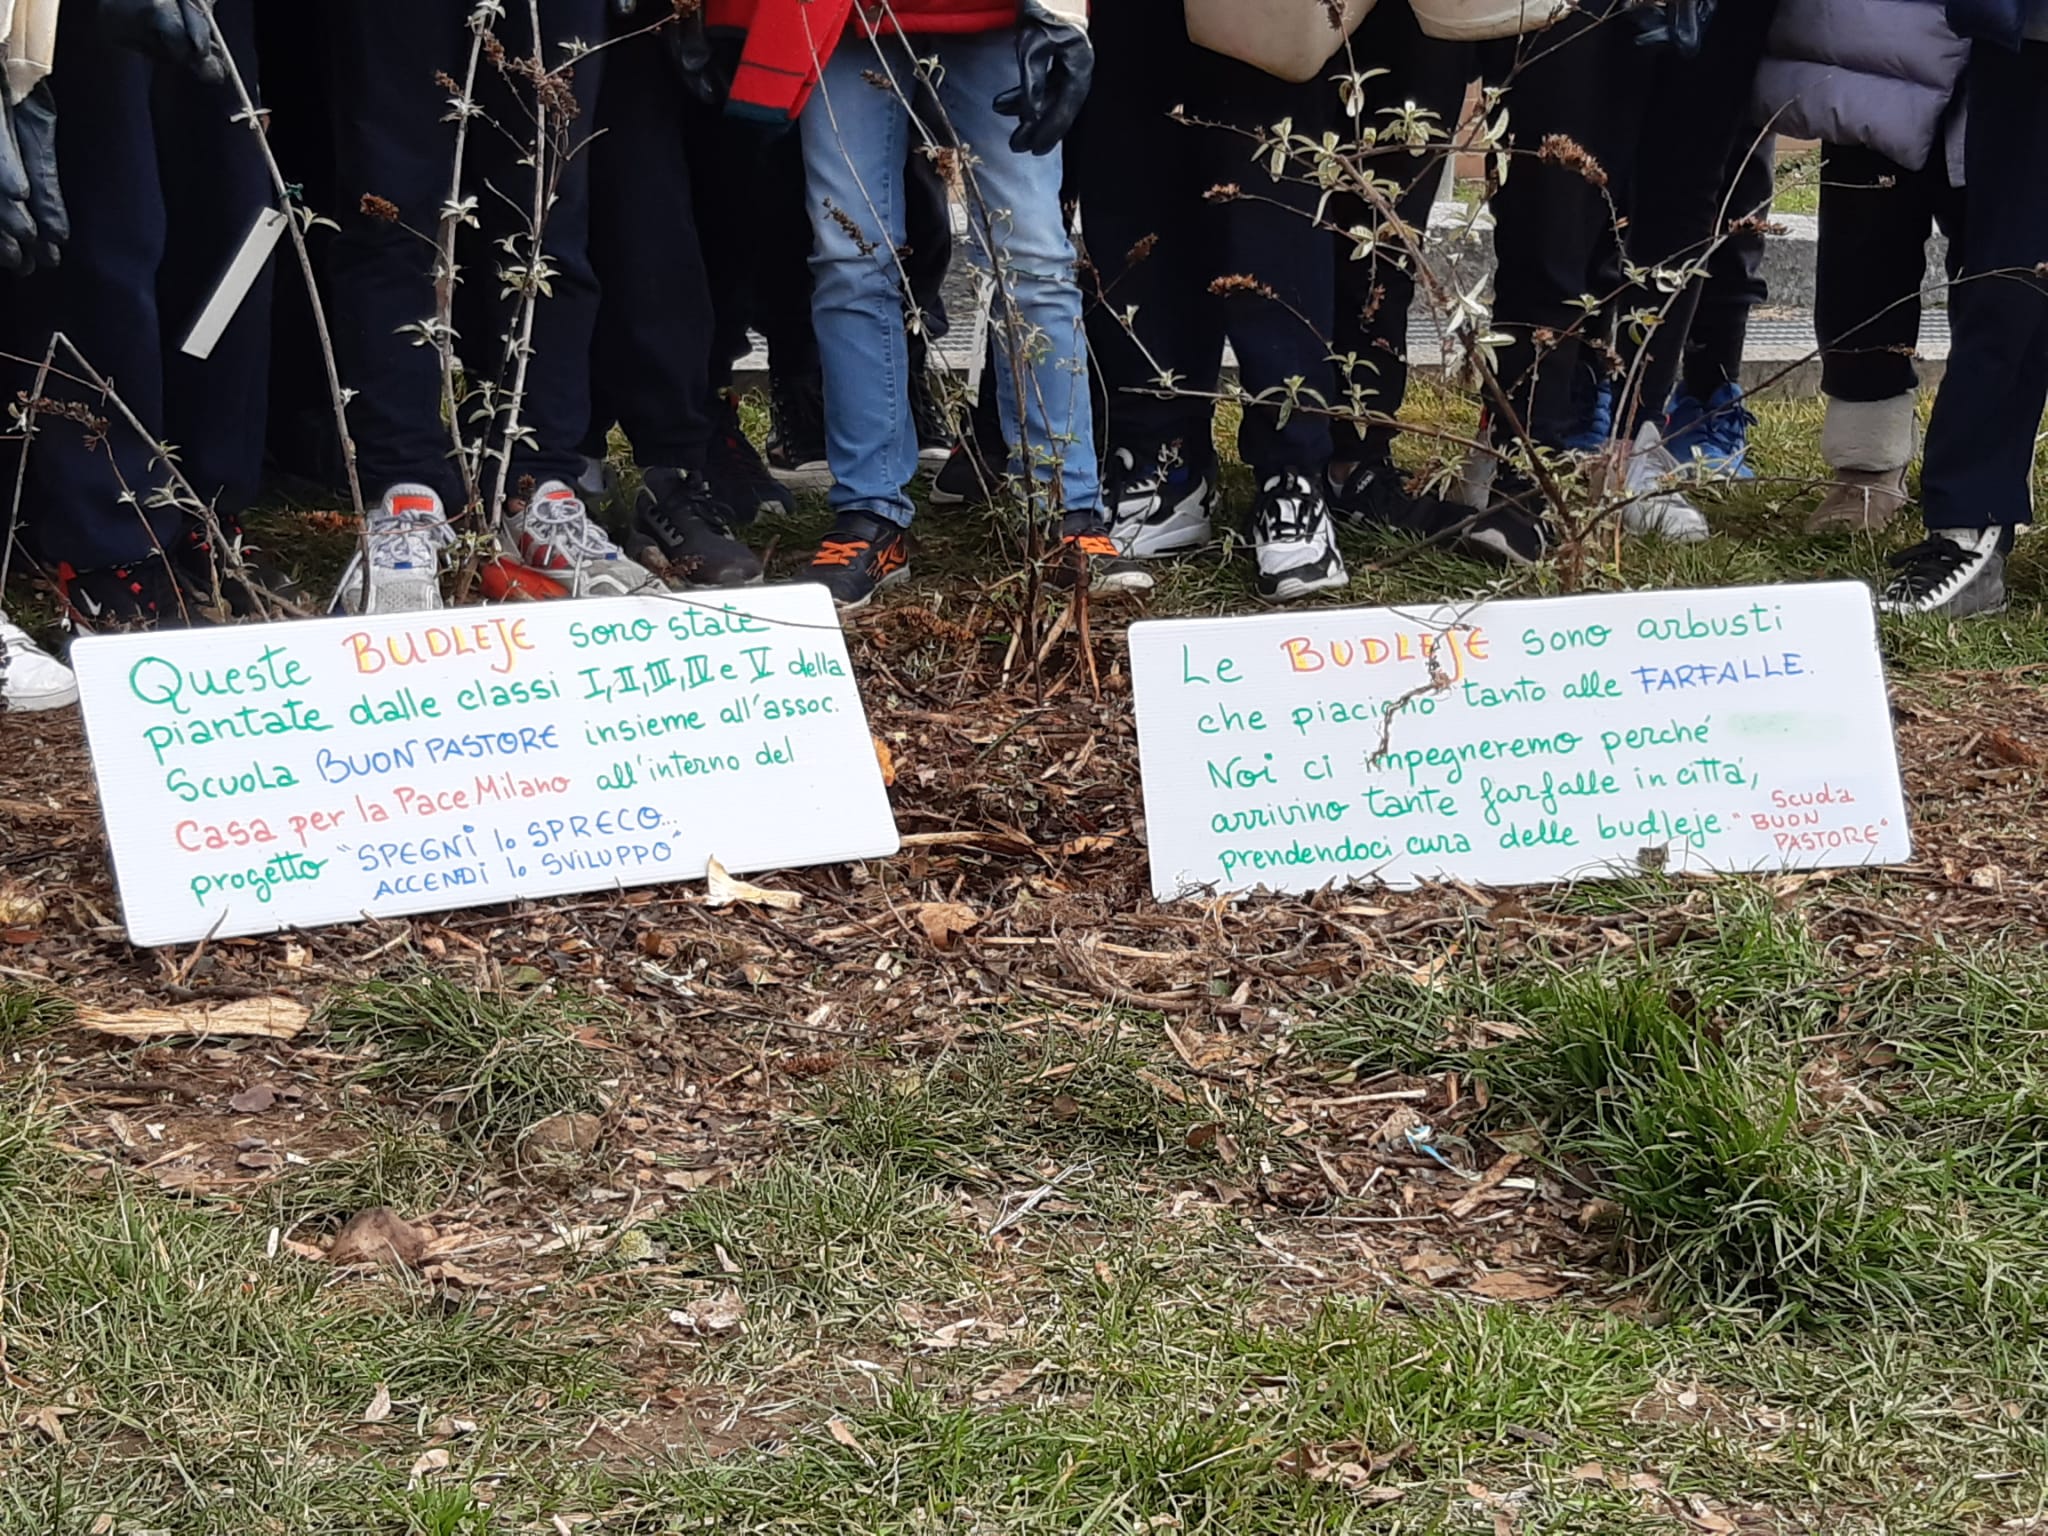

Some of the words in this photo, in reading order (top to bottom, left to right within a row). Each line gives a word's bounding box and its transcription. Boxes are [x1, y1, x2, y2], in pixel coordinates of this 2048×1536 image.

[130, 645, 312, 714] Queste
[342, 618, 535, 674] BUDLEJE
[668, 602, 771, 643] state
[1183, 644, 1243, 685] Le
[1280, 625, 1489, 682] BUDLEJE
[1637, 603, 1784, 641] arbusti
[143, 699, 334, 766] piantate
[349, 687, 442, 726] dalle
[457, 671, 561, 711] classi
[720, 663, 738, 681] e
[740, 646, 776, 684] V
[788, 647, 846, 682] della
[1197, 703, 1267, 734] che
[1461, 677, 1546, 708] tanto
[1563, 671, 1623, 699] alle
[316, 739, 418, 784] BUON
[425, 724, 560, 764] PASTORE
[584, 711, 706, 746] insieme
[1207, 753, 1277, 790] Noi
[1303, 754, 1334, 780] ci
[1601, 715, 1711, 765] perché
[176, 820, 278, 853] Casa
[288, 809, 346, 848] per
[355, 794, 390, 823] la
[393, 786, 470, 816] Pace
[474, 771, 571, 805] Milano
[756, 736, 795, 767] del
[1211, 797, 1349, 834] arrivino
[1362, 785, 1459, 818] tante
[1481, 769, 1620, 826] farfalle
[1636, 767, 1667, 790] in
[191, 851, 329, 907] progetto
[494, 828, 516, 853] lo
[506, 856, 527, 878] lo
[1218, 836, 1393, 882] prendendoci
[1405, 832, 1472, 856] cura
[1499, 817, 1580, 849] delle
